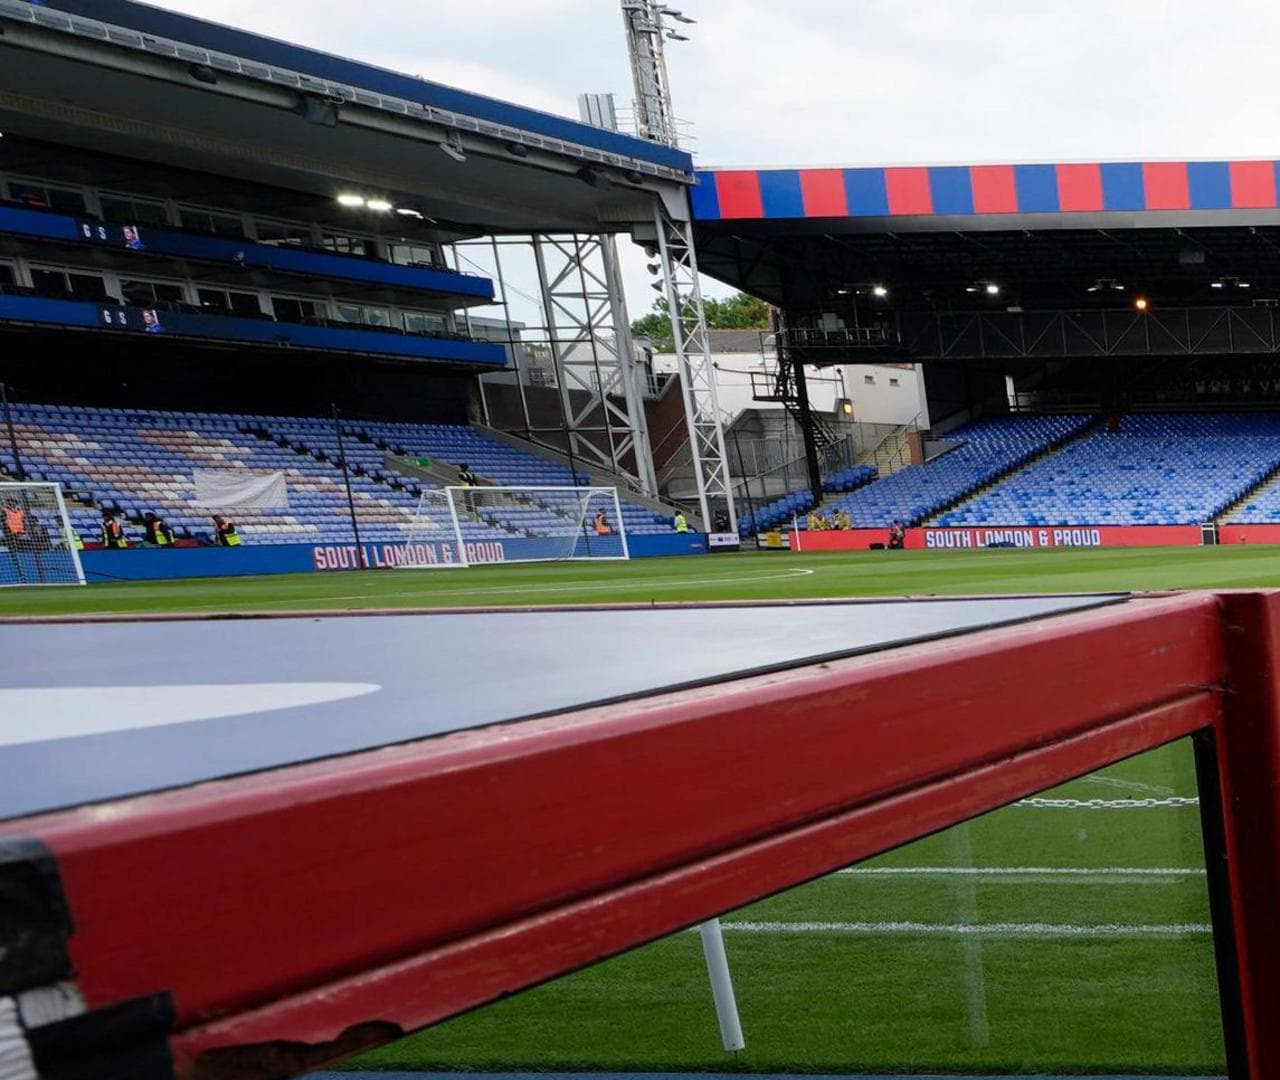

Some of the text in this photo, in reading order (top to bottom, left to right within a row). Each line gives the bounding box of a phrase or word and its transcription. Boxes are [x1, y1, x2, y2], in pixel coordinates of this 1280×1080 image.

[926, 529, 1100, 548] SOUTH LONDON & PROUD
[372, 544, 438, 567] LONDON
[457, 542, 505, 565] ROUD
